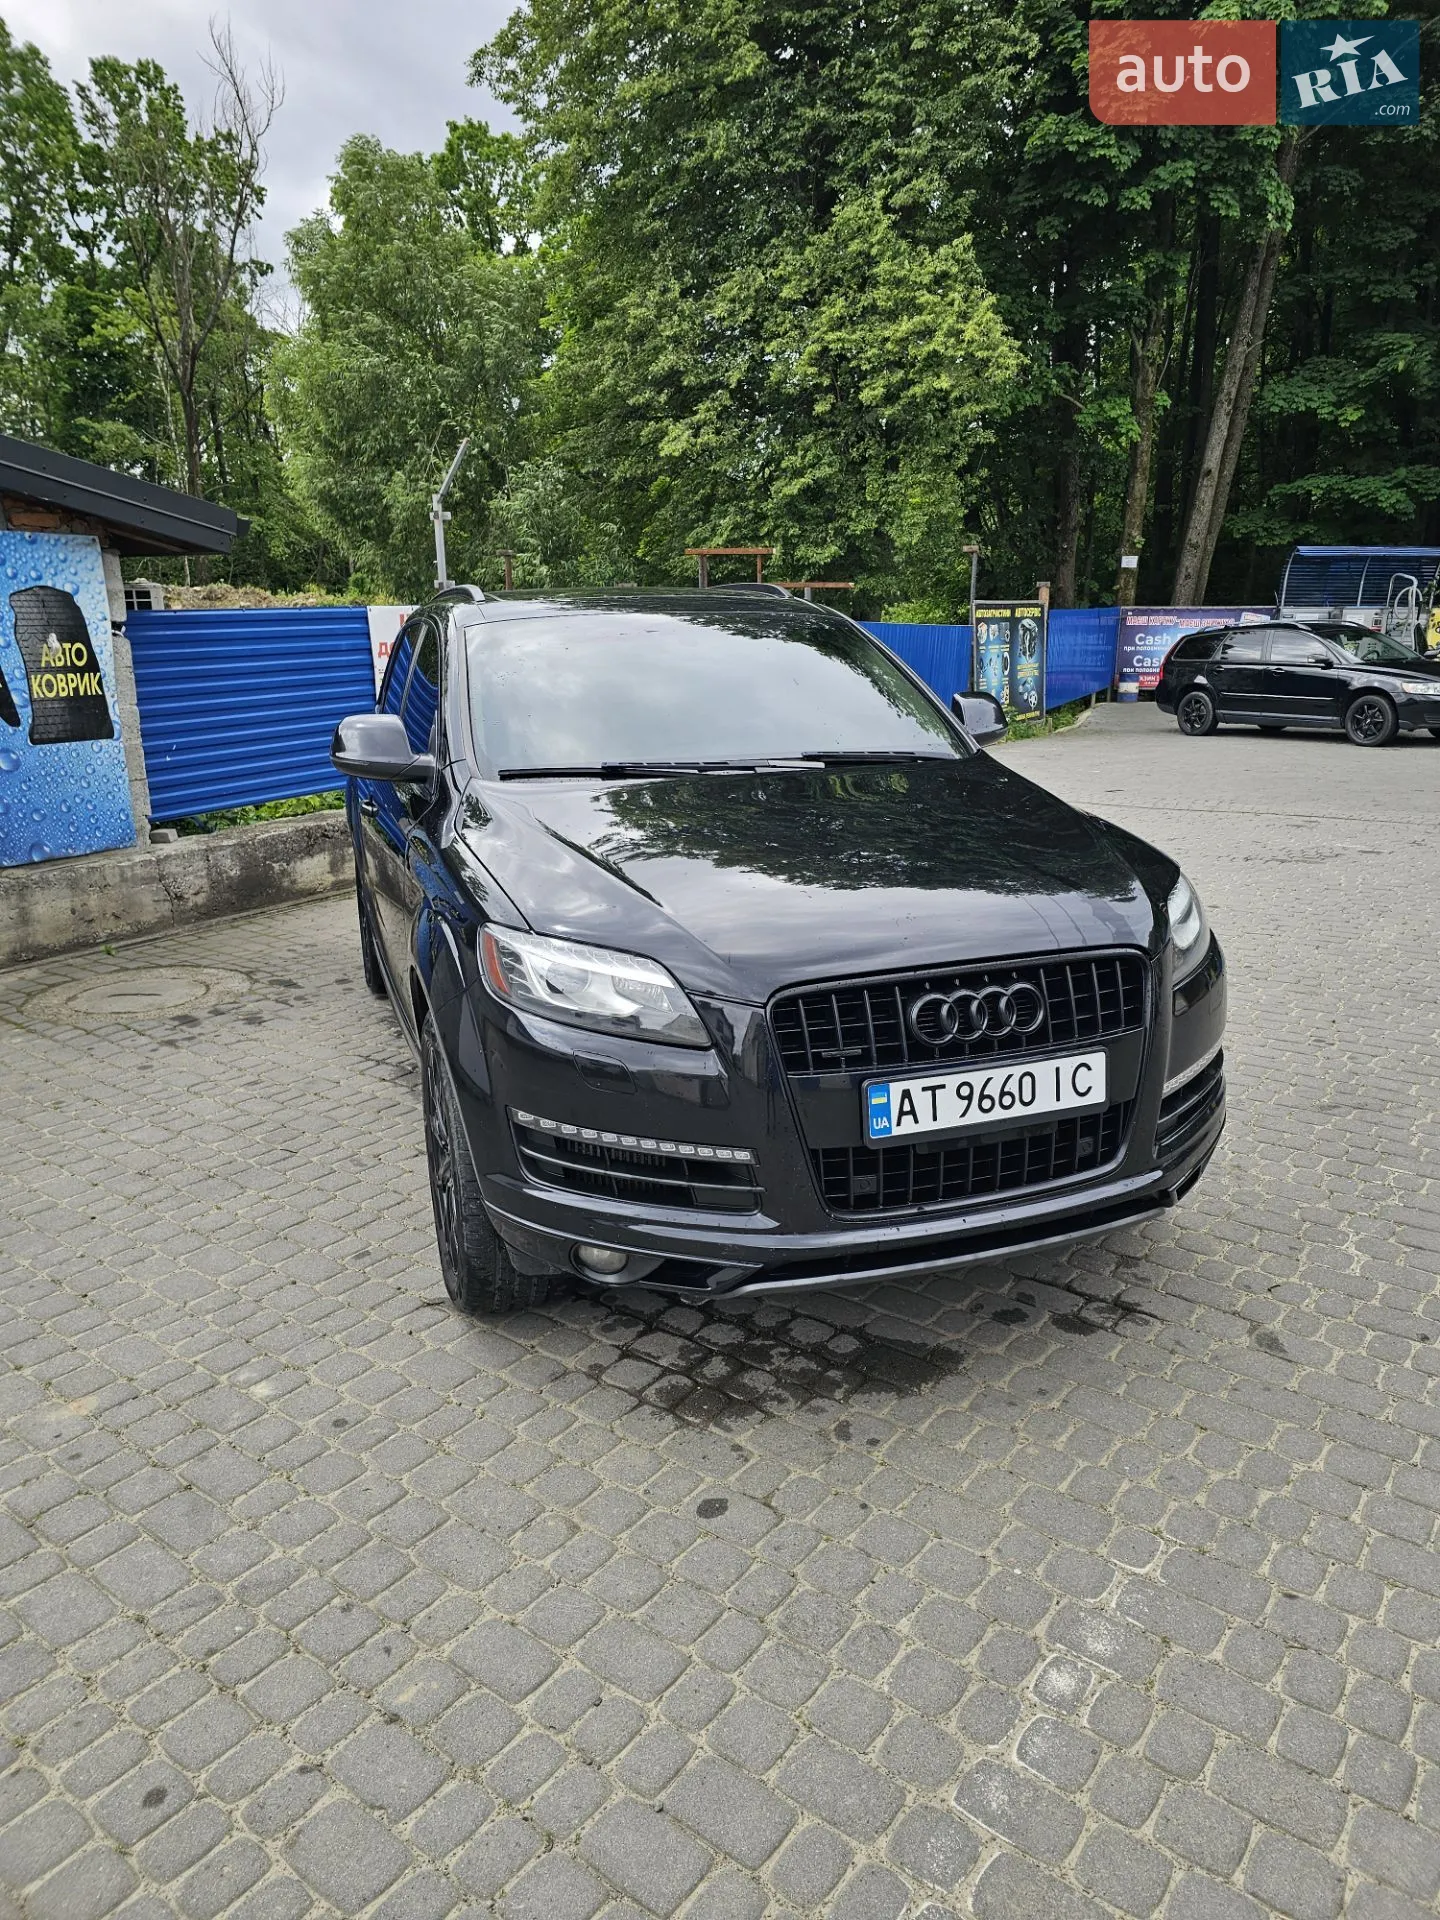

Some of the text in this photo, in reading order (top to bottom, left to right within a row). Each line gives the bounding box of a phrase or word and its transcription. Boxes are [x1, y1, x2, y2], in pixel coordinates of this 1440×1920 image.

[1135, 633, 1171, 645] Cash
[31, 673, 102, 698] КОВРИК
[896, 1062, 1093, 1127] AT 9660 IC
[873, 1116, 889, 1130] UA
